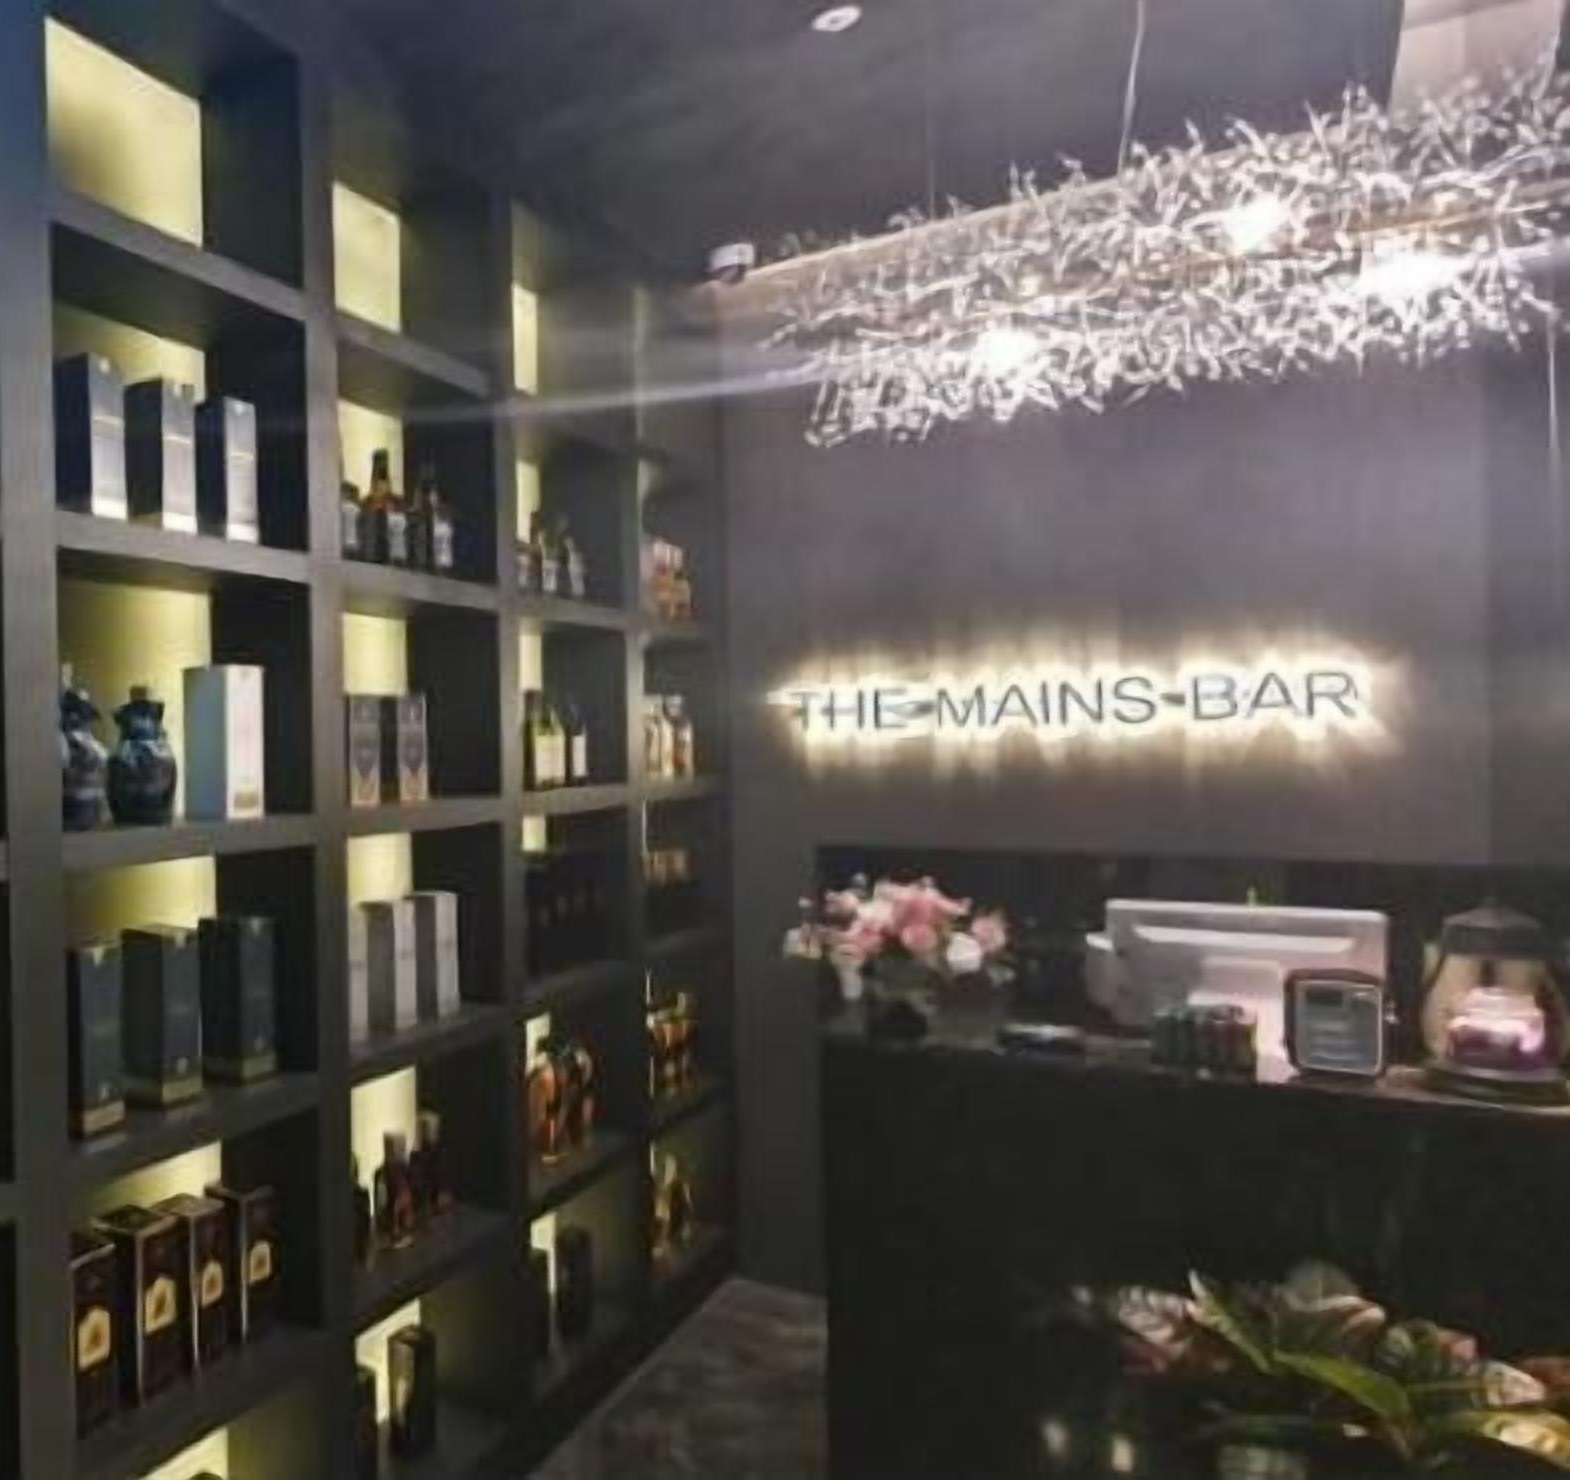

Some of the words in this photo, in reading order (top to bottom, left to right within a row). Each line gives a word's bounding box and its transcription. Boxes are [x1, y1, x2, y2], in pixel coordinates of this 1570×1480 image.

[789, 688, 907, 731] THE
[937, 675, 1158, 728] MAINS
[1192, 671, 1358, 721] BAR
